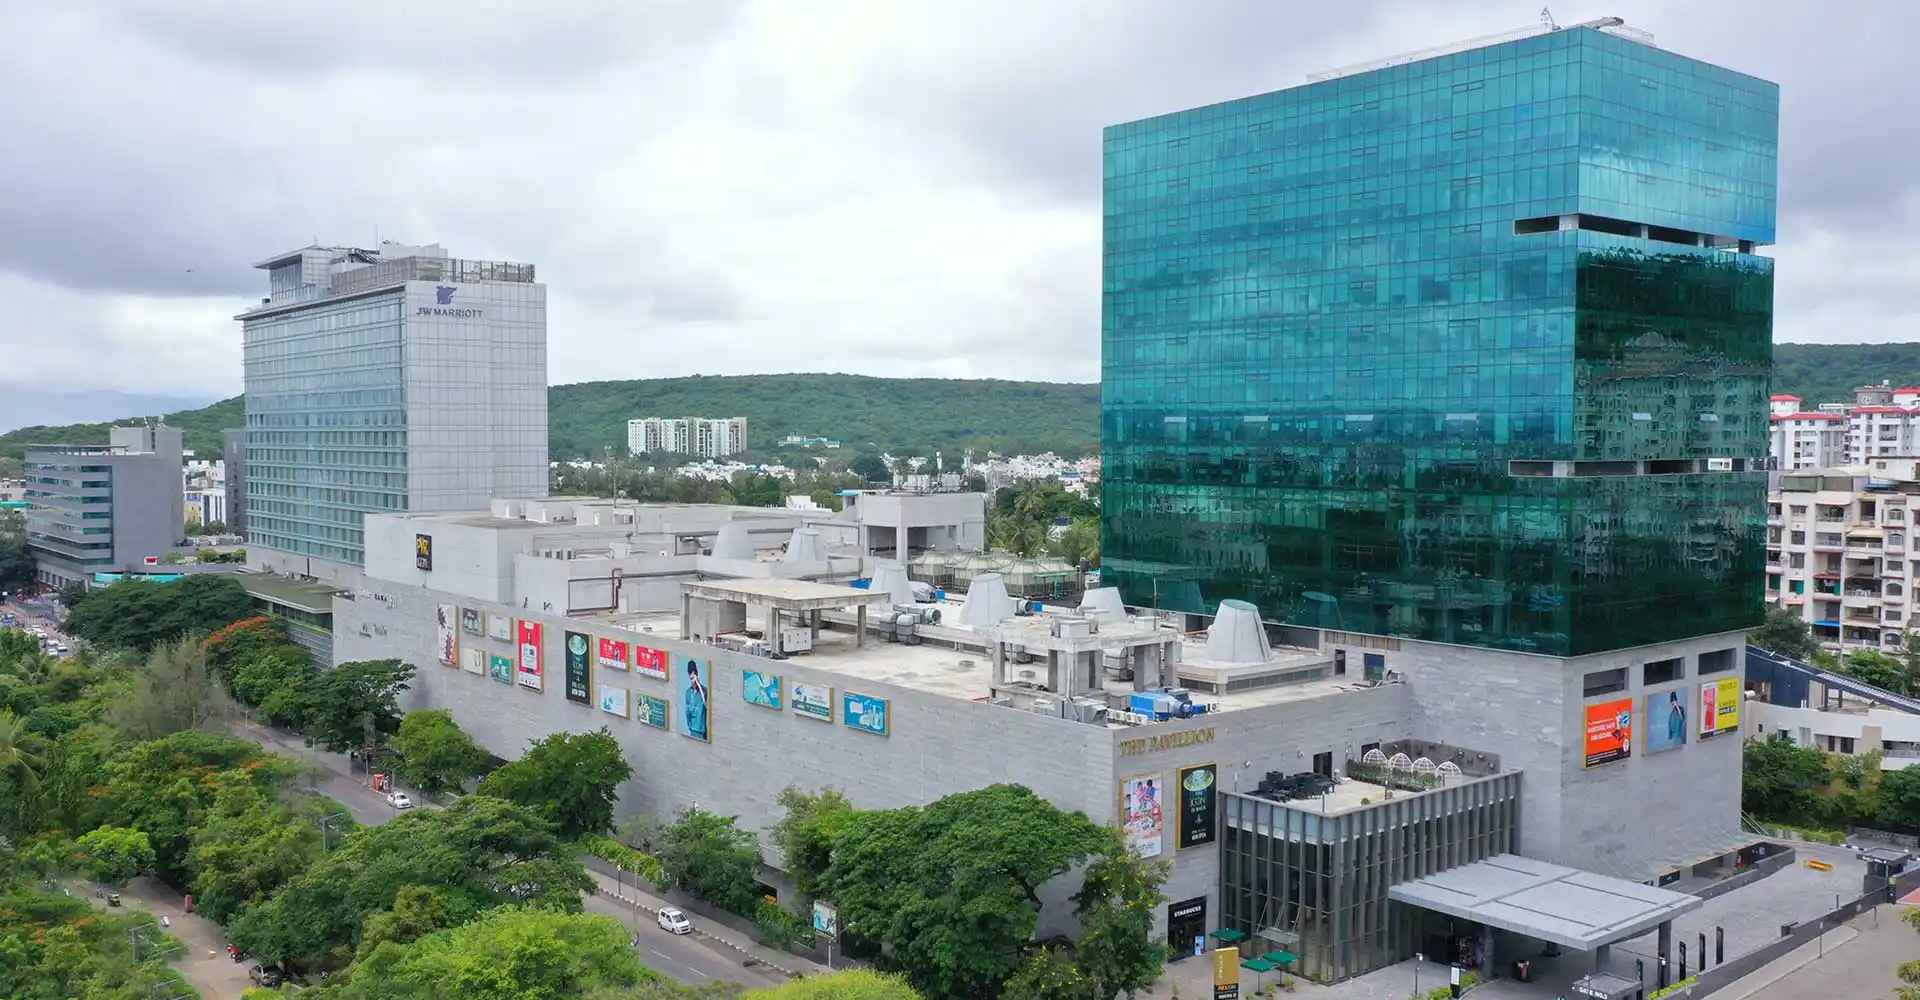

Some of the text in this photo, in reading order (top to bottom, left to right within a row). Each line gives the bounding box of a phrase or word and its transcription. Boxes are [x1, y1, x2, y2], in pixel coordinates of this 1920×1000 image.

[416, 307, 483, 319] JW MARRIOTT
[1120, 738, 1145, 756] THE
[1174, 905, 1201, 918] STARBUCKS
